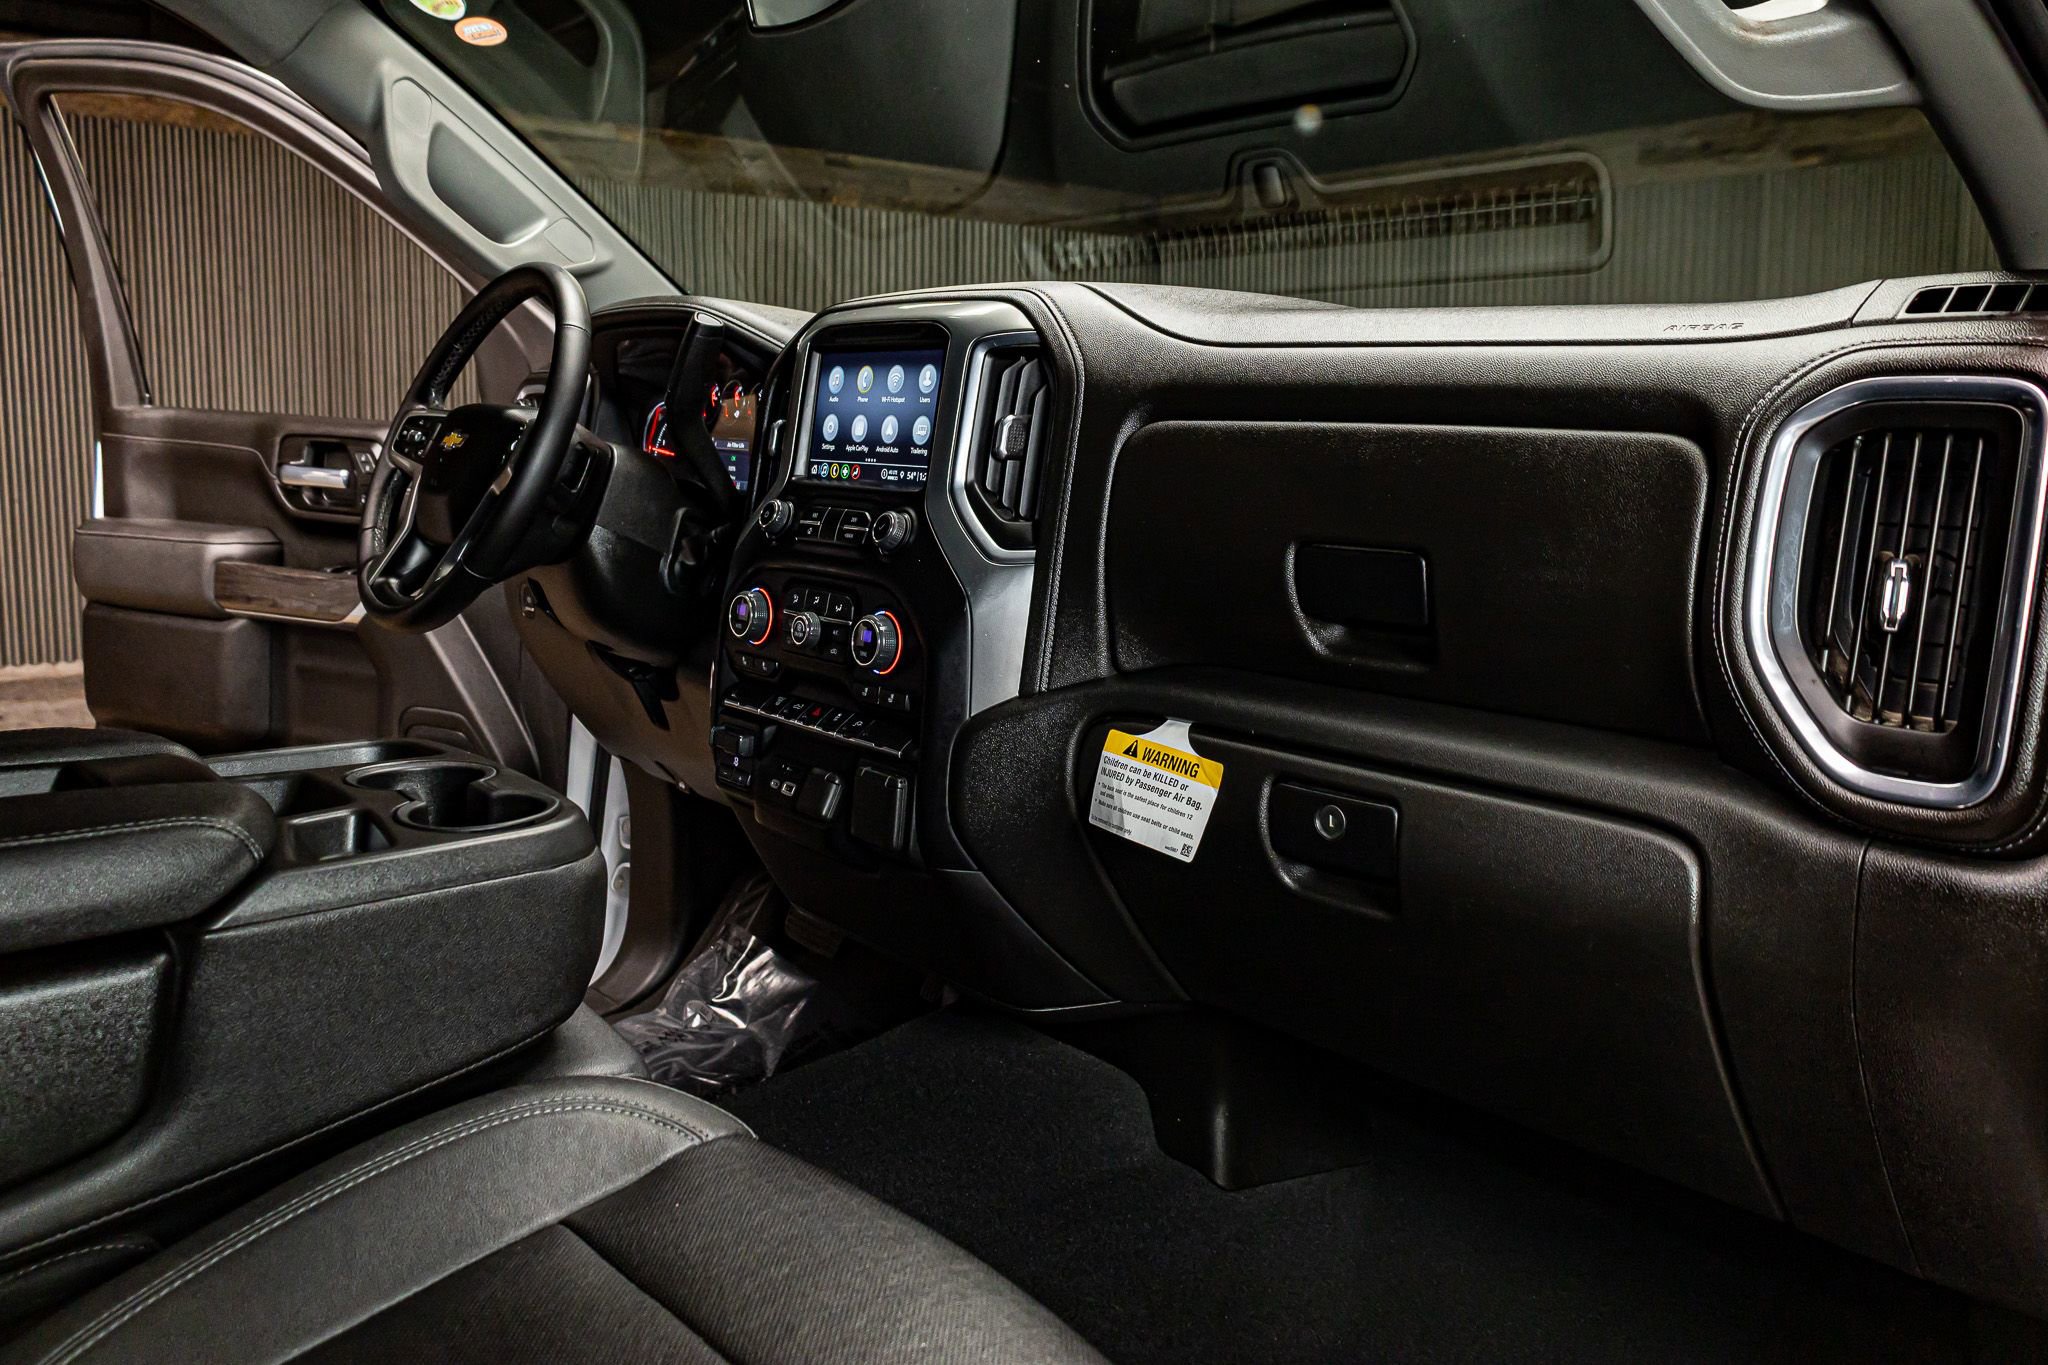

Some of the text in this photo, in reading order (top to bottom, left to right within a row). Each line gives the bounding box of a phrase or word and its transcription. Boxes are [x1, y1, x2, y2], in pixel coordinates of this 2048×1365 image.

[1663, 322, 1744, 332] AIRBAG
[821, 443, 835, 452] Settings
[855, 445, 869, 453] CarPlay
[910, 447, 928, 456] Trailering
[1103, 755, 1189, 791] Children can be KILLED or
[1142, 746, 1200, 778] WARNING
[1100, 766, 1203, 811] INJURED by Passenger Air Bag.
[1134, 794, 1147, 804] safest
[1147, 799, 1160, 808] place
[1167, 807, 1186, 818] children
[1118, 806, 1132, 816] children
[1150, 819, 1162, 828] belts
[1168, 826, 1180, 835] child
[1180, 831, 1194, 840] seats.
